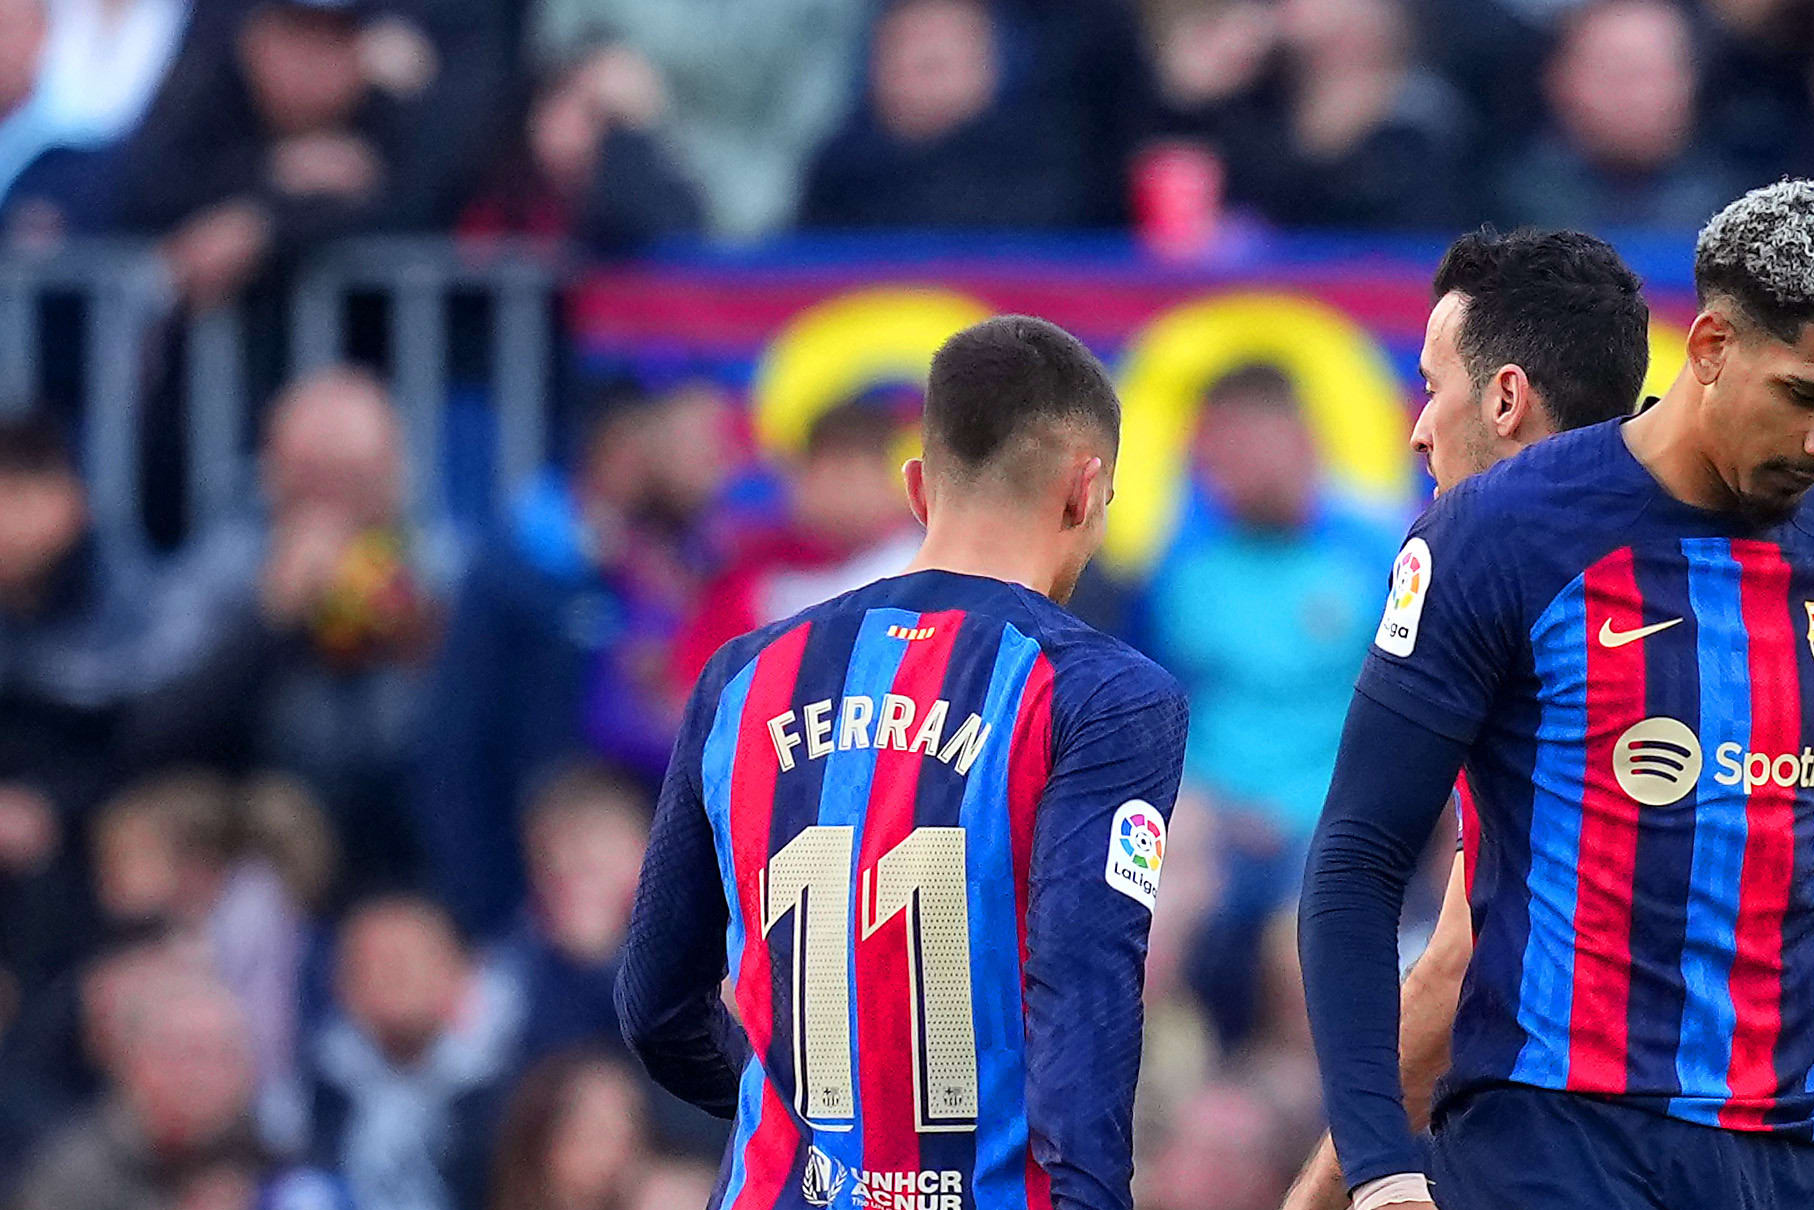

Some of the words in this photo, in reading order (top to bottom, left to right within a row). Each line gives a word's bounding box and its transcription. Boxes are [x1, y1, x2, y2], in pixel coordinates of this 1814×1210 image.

[766, 693, 992, 776] FERRAN
[759, 825, 978, 1132] 11
[851, 1167, 962, 1193] UNHCR
